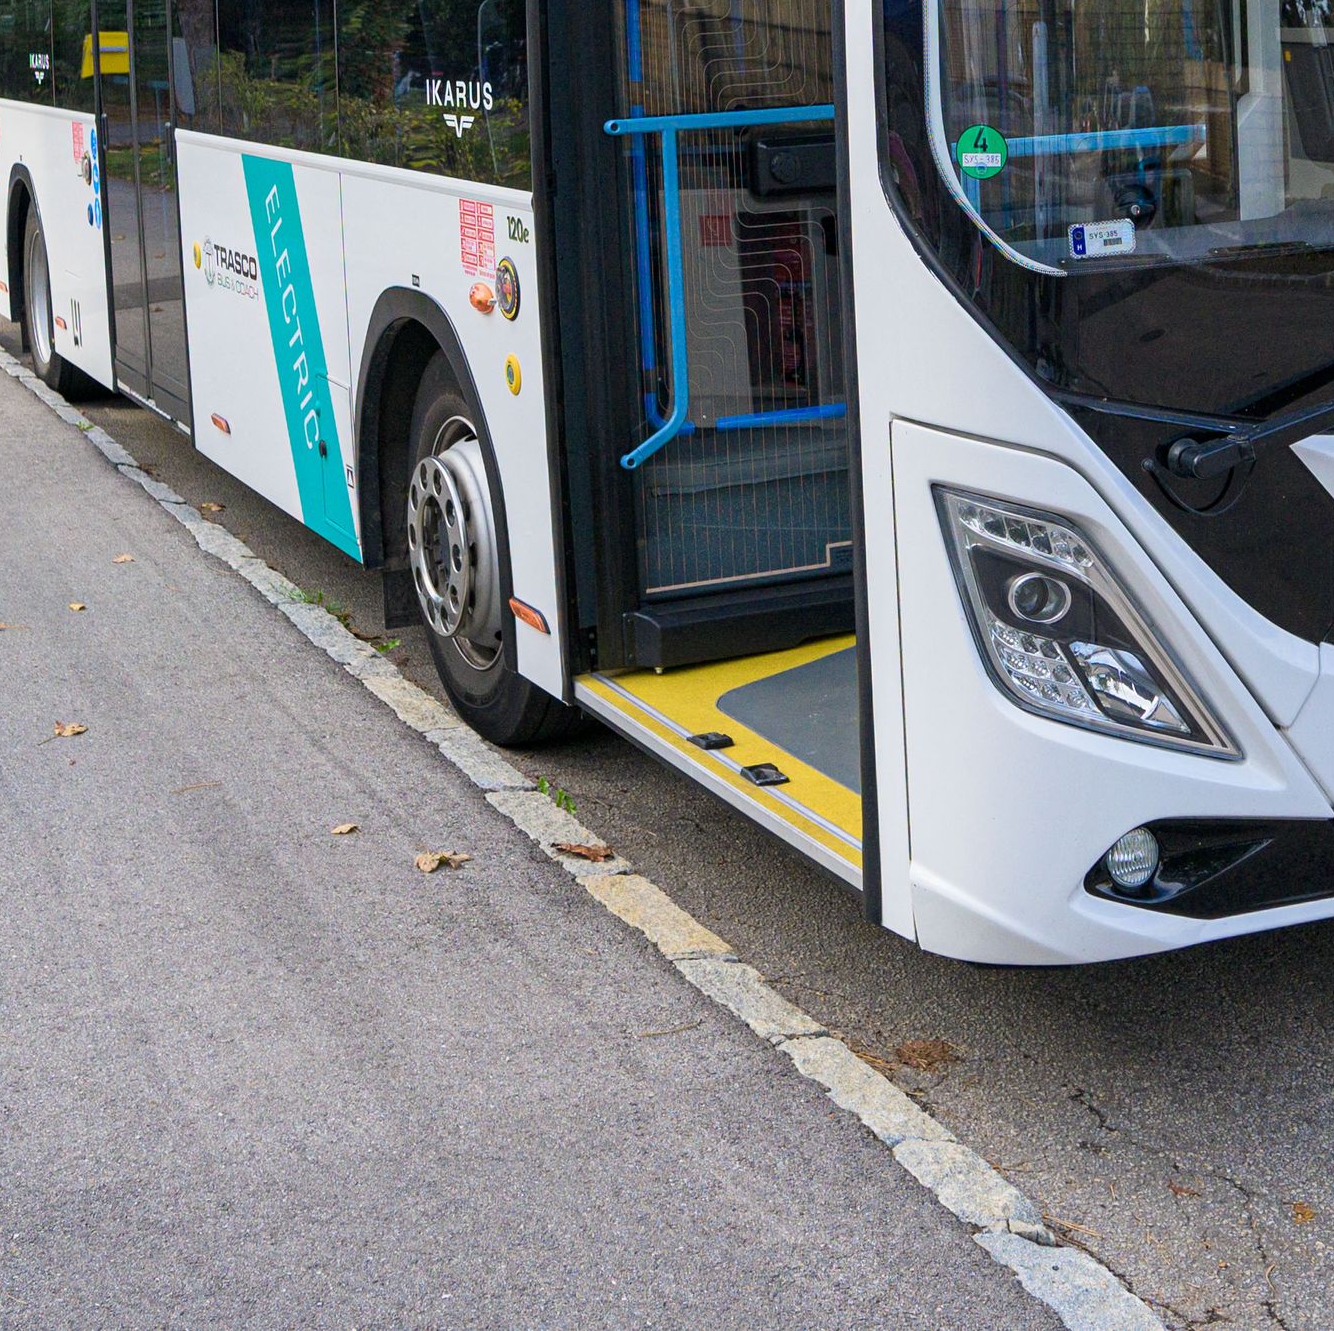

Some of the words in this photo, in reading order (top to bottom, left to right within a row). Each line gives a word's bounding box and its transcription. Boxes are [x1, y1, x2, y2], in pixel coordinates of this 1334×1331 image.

[29, 53, 50, 70] IKARUS
[426, 78, 493, 111] IKARUS
[974, 127, 989, 152] 4
[506, 215, 530, 244] 120e
[1089, 230, 1118, 240] SYS-385
[214, 243, 258, 281] TRASCO
[217, 272, 230, 290] BUS
[235, 279, 259, 302] COACH
[265, 184, 320, 450] ELECTRIC
